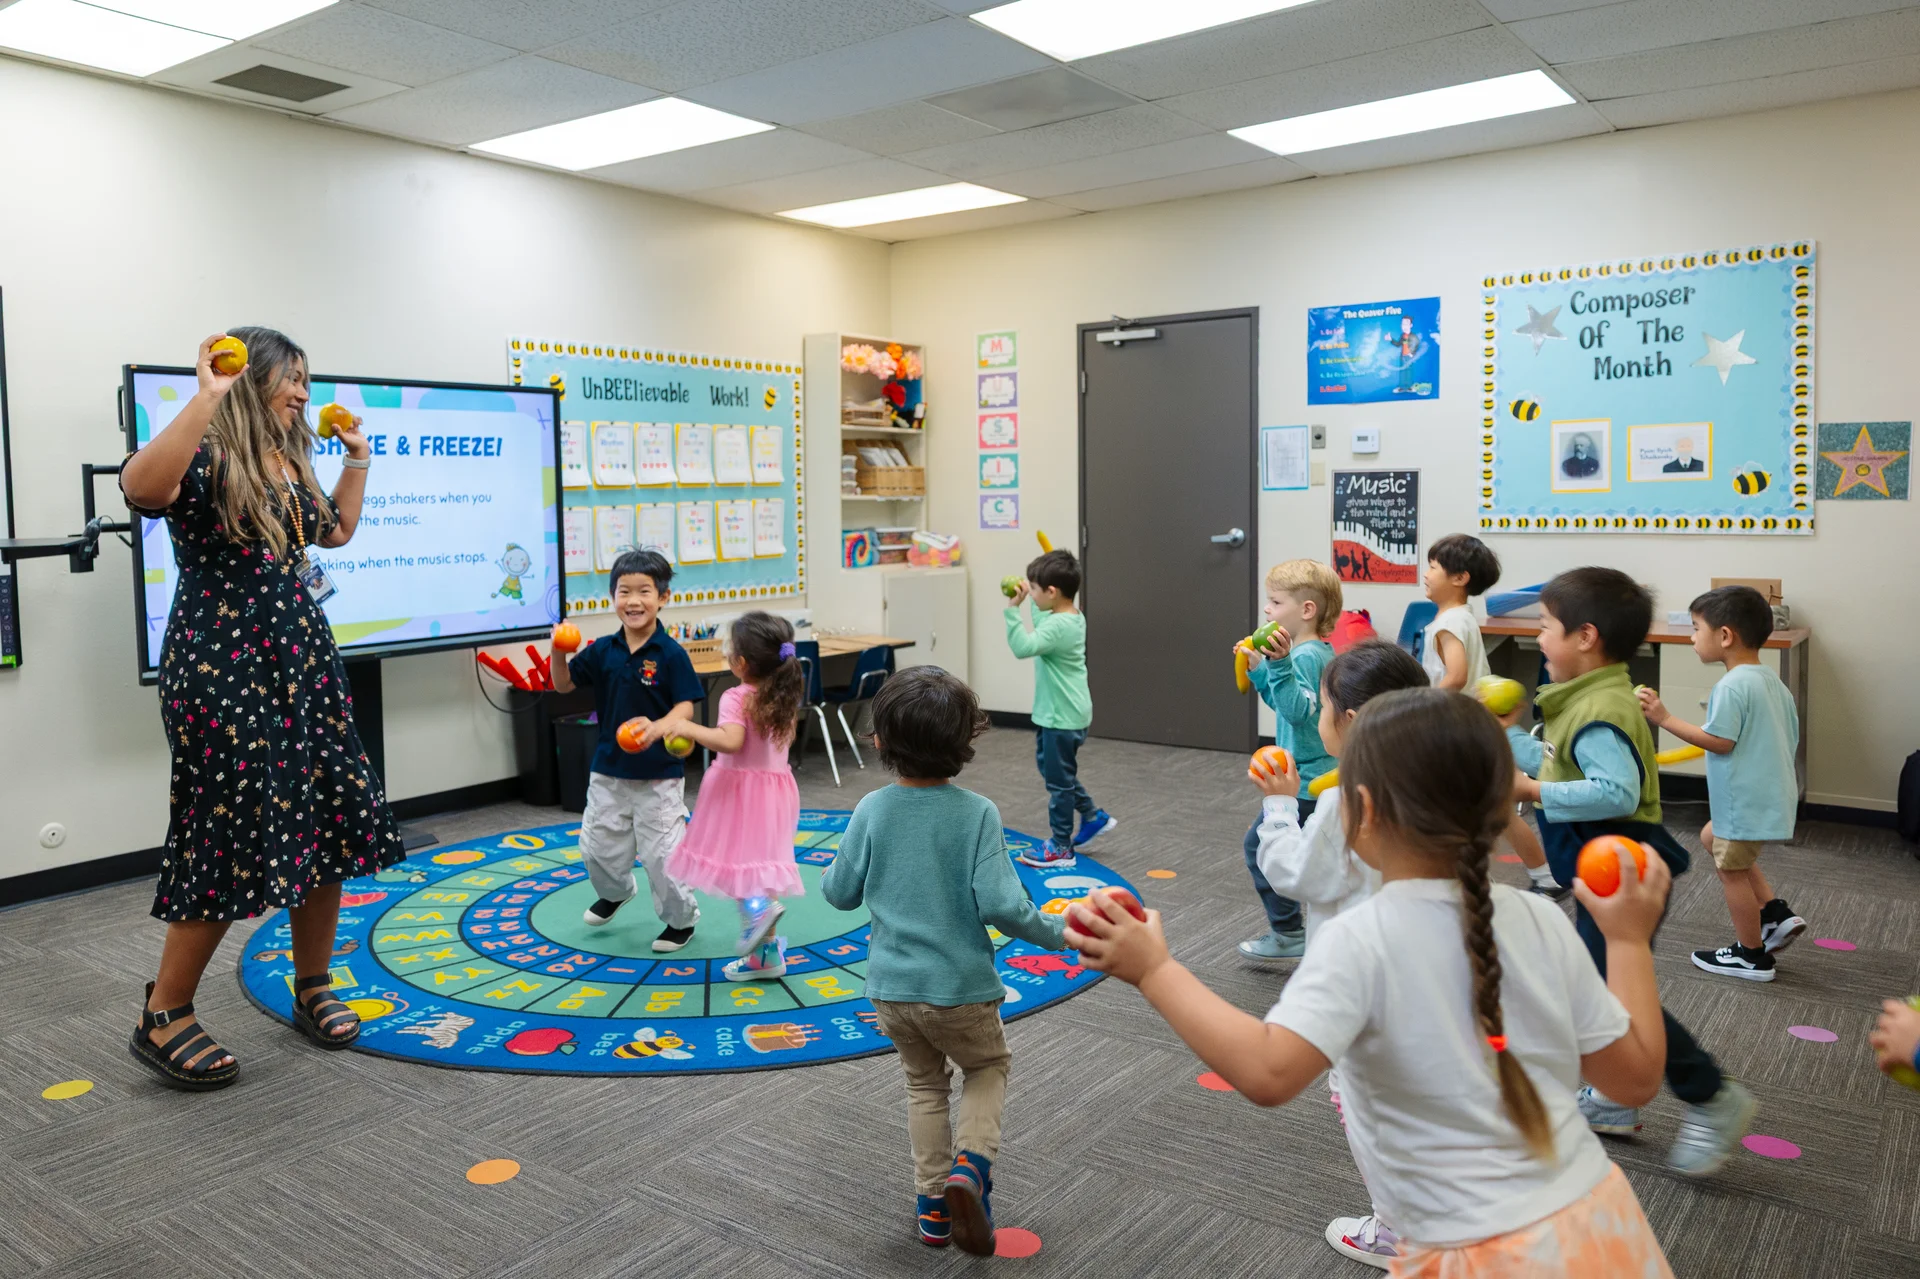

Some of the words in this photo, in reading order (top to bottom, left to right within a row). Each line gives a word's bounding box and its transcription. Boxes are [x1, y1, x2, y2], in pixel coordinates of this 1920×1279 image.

[1570, 286, 1696, 318] Composer
[1343, 310, 1357, 319] The
[1358, 309, 1384, 319] Quaver
[1385, 306, 1402, 316] Five
[1579, 320, 1610, 349] Of
[1637, 318, 1684, 344] The
[990, 338, 1003, 353] M
[1594, 351, 1673, 381] Month
[582, 376, 690, 404] UnBEElievable
[710, 385, 750, 407] Work!
[993, 418, 1003, 433] S
[396, 435, 410, 456] &
[419, 435, 503, 457] FREEZE!
[1346, 473, 1407, 495] Music
[363, 495, 386, 508] egg
[389, 492, 436, 505] shakers
[439, 491, 469, 504] when
[472, 494, 492, 506] you
[994, 500, 1004, 513] C
[1346, 496, 1369, 508] gives
[1371, 496, 1395, 508] wings
[1397, 497, 1407, 507] to
[360, 514, 380, 526] the
[383, 513, 421, 526] music.
[1350, 507, 1364, 518] the
[1366, 507, 1388, 518] mind
[1390, 507, 1406, 518] and
[1370, 518, 1394, 530] flight
[1396, 518, 1406, 529] to
[1391, 529, 1406, 539] the
[358, 558, 390, 569] when
[394, 555, 414, 567] the
[417, 553, 451, 565] music
[453, 552, 488, 566] stops.
[513, 880, 560, 892] 20
[492, 893, 533, 904] 21
[473, 907, 524, 919] 22
[377, 929, 453, 943] Ww
[469, 920, 521, 935] 23
[481, 933, 535, 951] 24
[827, 944, 859, 956] 5
[391, 946, 461, 965] Xx
[506, 944, 560, 964] 25
[545, 954, 597, 973] 26
[663, 966, 697, 977] 2
[433, 966, 496, 986] Yy
[999, 969, 1047, 986] fish
[483, 978, 543, 1001] Zz
[803, 975, 856, 999] Dd
[555, 986, 608, 1010] Aa
[644, 991, 687, 1013] Bb
[729, 986, 765, 1008] Cc
[359, 1004, 442, 1037] zebra
[830, 1017, 866, 1041] dog
[465, 1020, 527, 1055] apple
[588, 1033, 626, 1057] bee
[715, 1027, 741, 1057] cake
